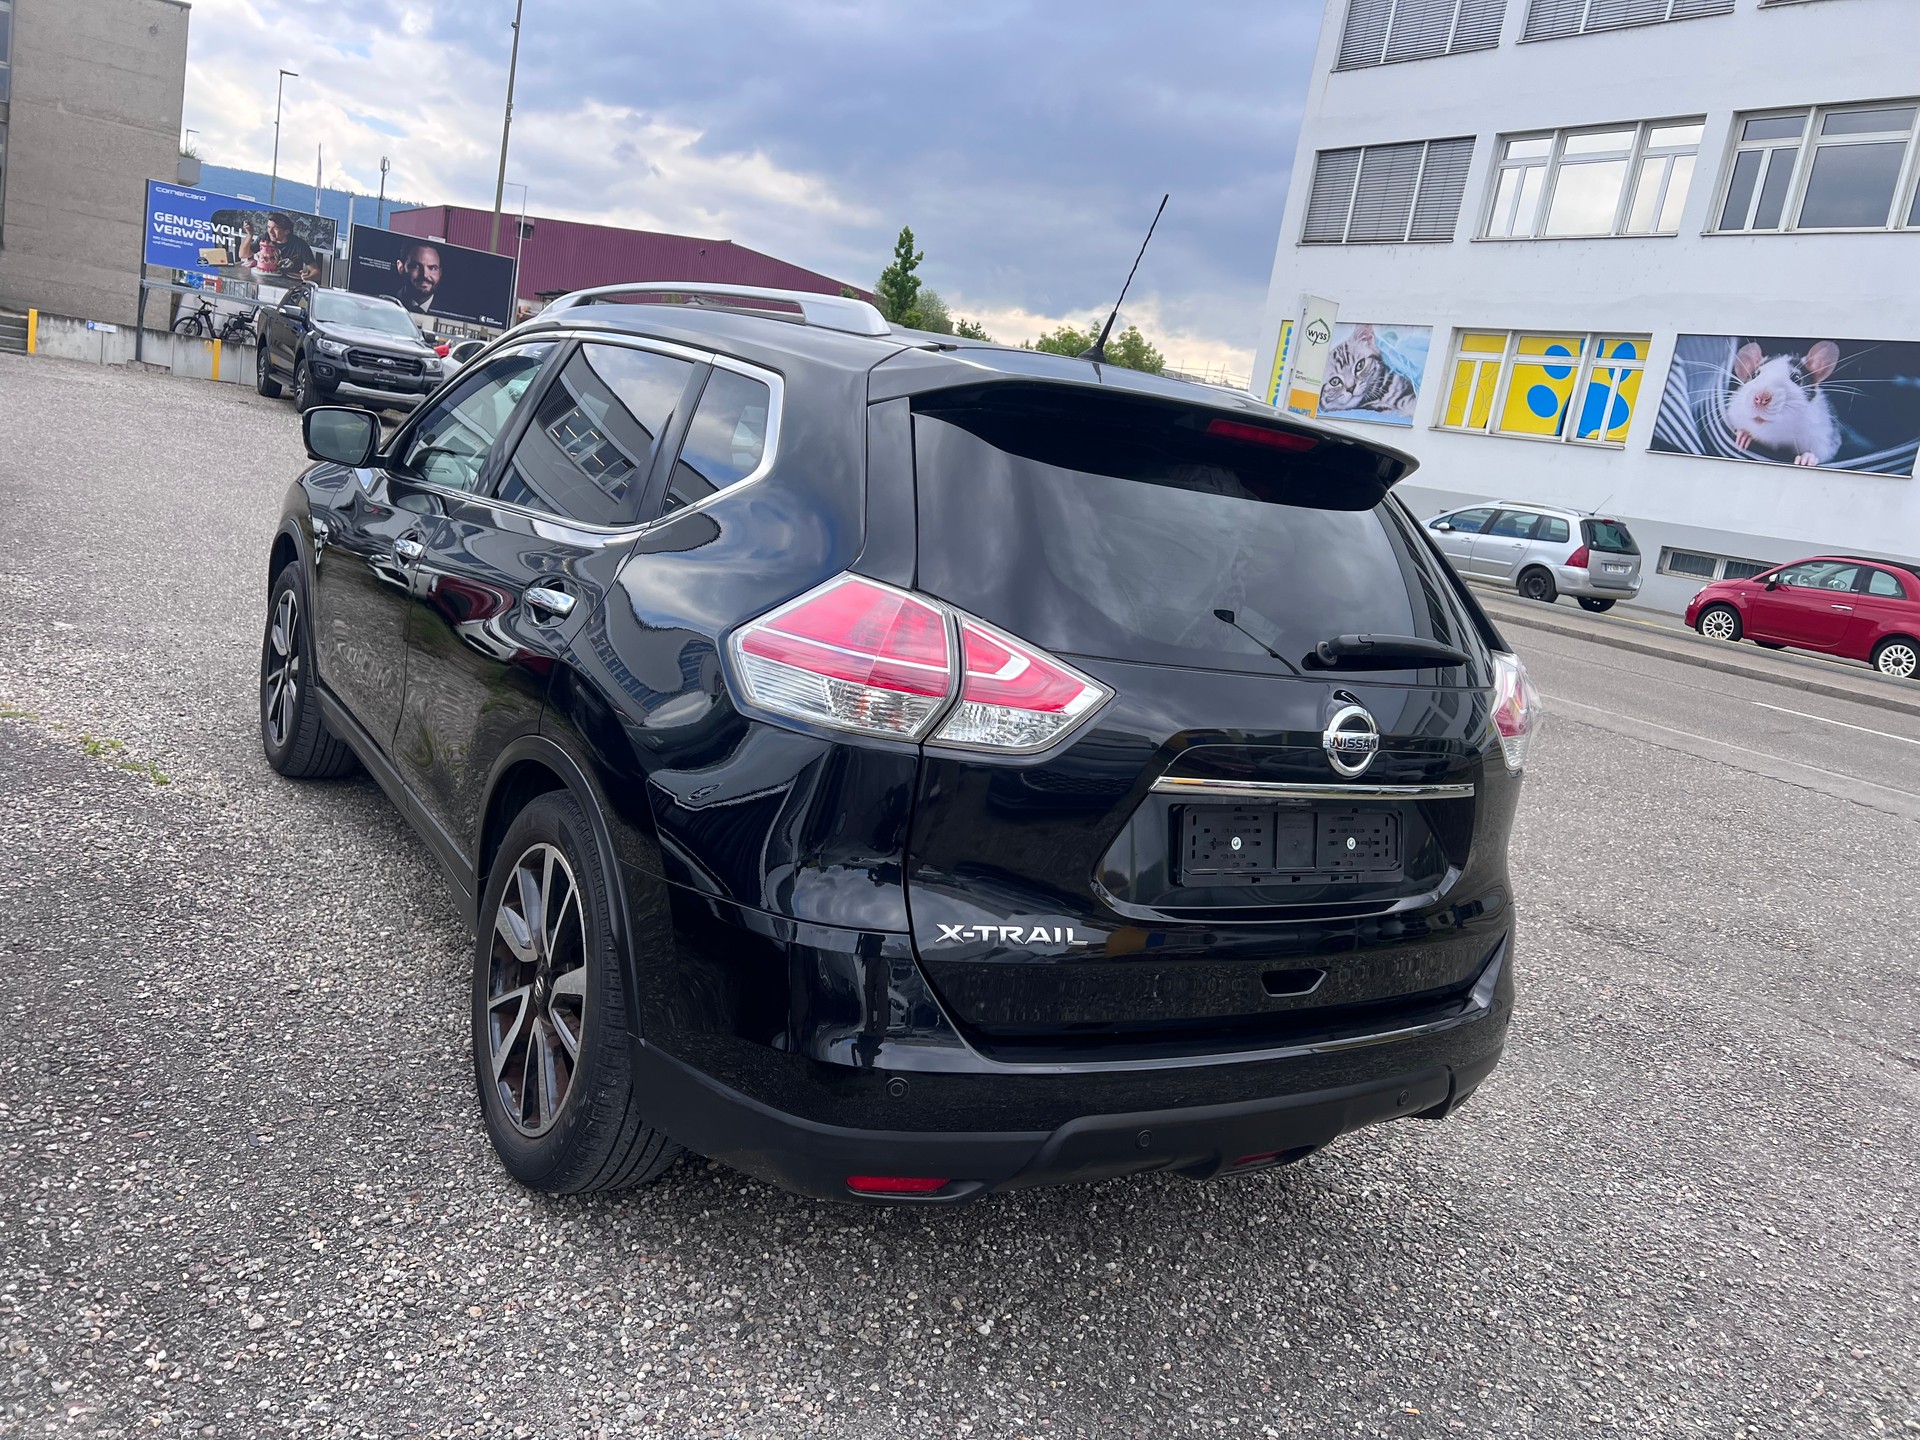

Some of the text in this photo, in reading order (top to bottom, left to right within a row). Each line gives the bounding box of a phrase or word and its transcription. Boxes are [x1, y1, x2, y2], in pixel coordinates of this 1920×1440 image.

[153, 222, 236, 247] VERWÖHNT.
[154, 211, 247, 238] GENUSSVOLL
[1307, 328, 1328, 346] wyss
[1330, 736, 1377, 751] NISSAN
[934, 923, 1089, 947] X-TRAIL
